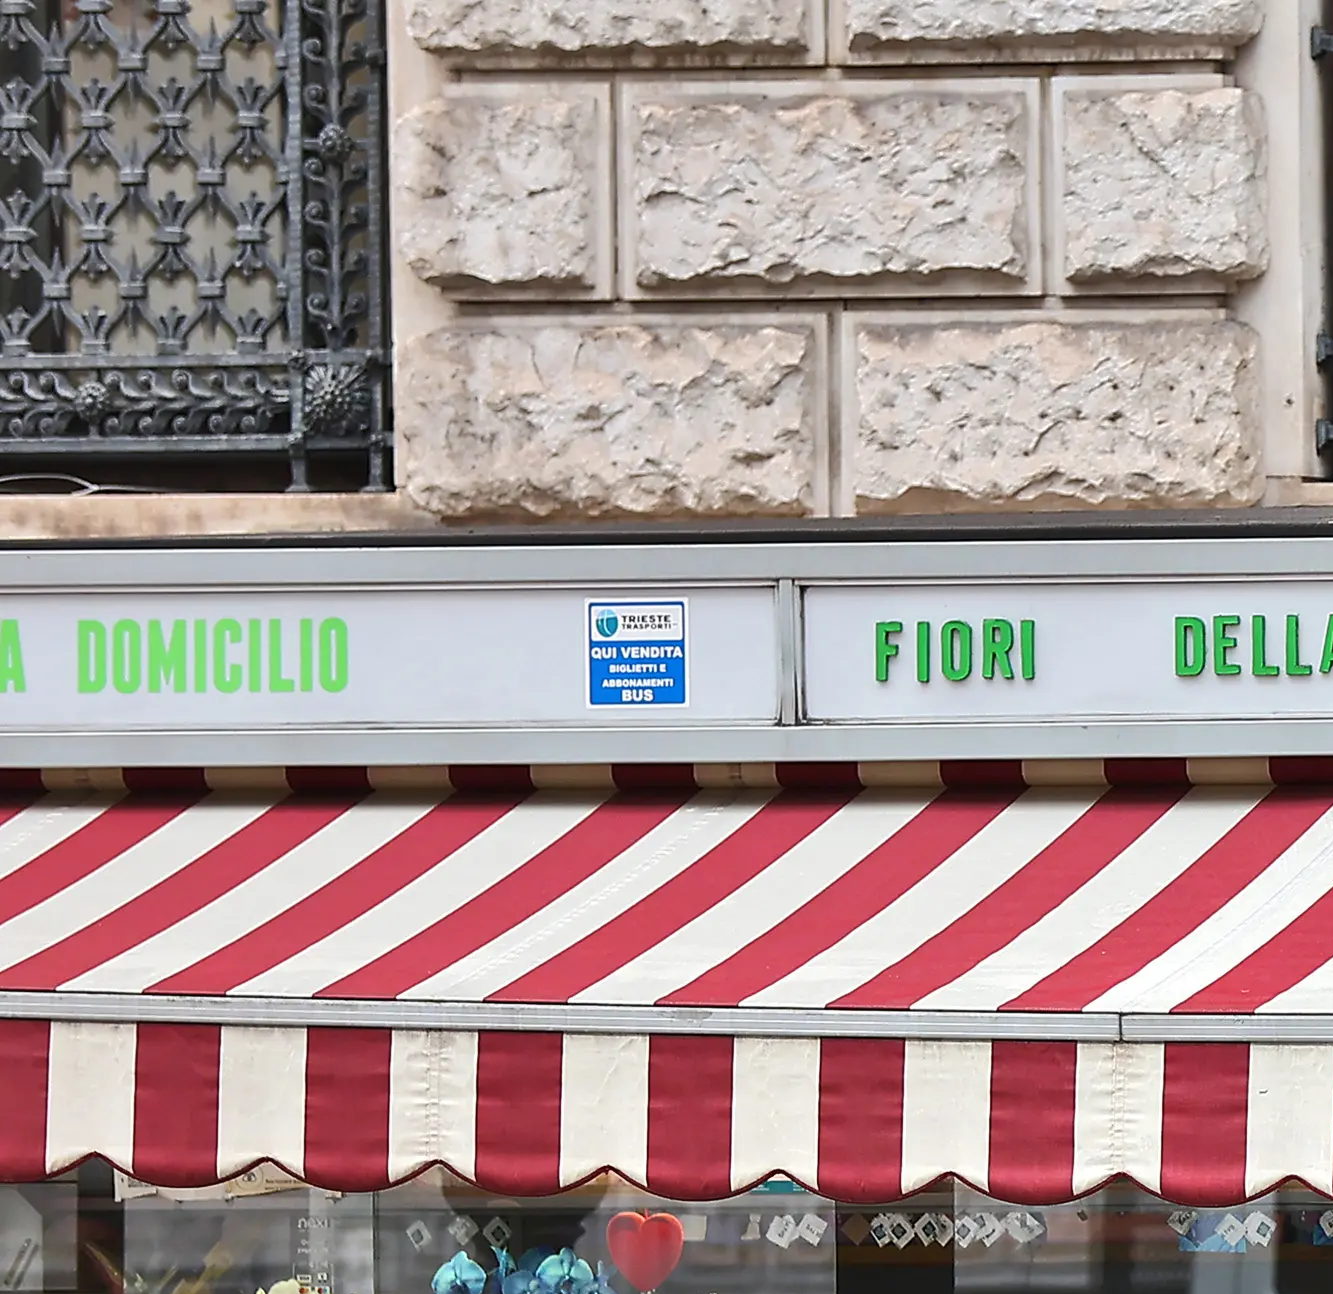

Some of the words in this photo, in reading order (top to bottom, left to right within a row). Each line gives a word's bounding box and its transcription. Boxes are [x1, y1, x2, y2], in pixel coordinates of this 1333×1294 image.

[622, 614, 671, 623] TRIESTE
[76, 617, 349, 694] DOMICILIO
[591, 647, 617, 660] QUI
[621, 646, 683, 659] VENDITA
[874, 618, 1037, 683] FIORI
[609, 664, 657, 673] BIGLIETTI
[659, 664, 667, 673] E
[602, 678, 674, 688] ABBONAMENTI
[622, 689, 654, 702] BUS
